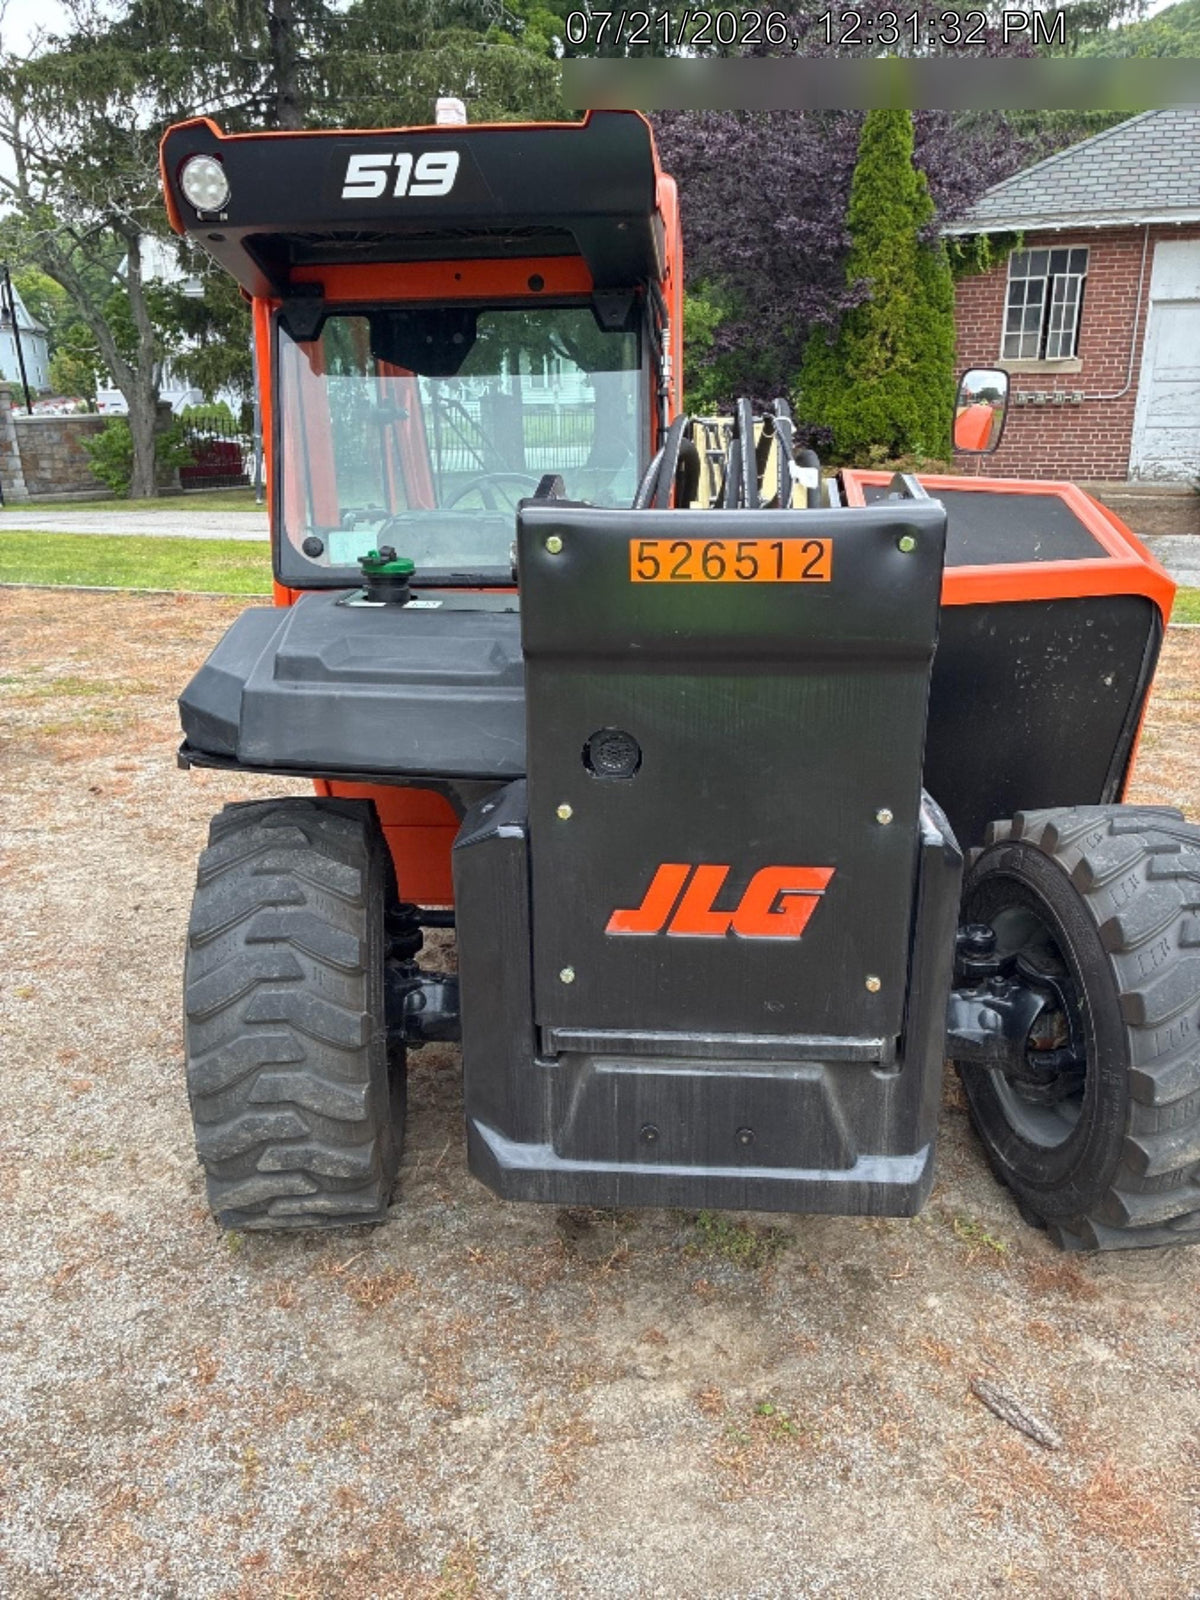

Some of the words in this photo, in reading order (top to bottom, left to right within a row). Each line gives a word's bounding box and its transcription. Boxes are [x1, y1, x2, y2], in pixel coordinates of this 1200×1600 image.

[342, 151, 460, 198] 519
[637, 541, 825, 580] 526512
[605, 863, 836, 941] JLG
